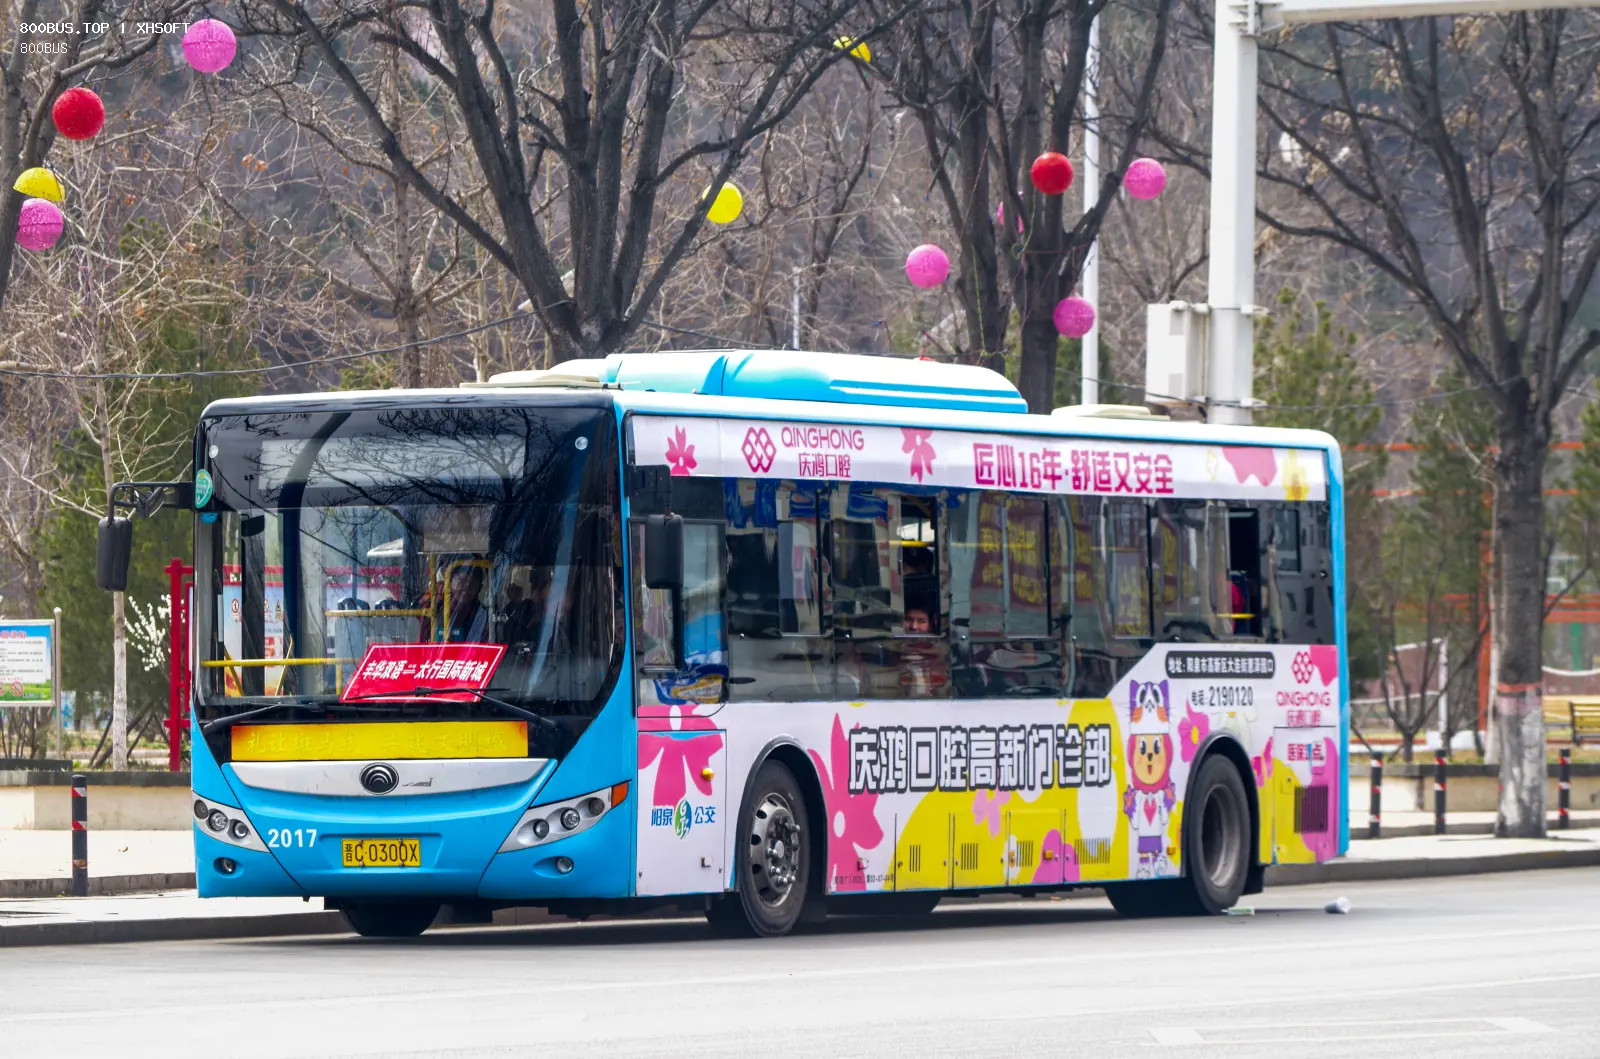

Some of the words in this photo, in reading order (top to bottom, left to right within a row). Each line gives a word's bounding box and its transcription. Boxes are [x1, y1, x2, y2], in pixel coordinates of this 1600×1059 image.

[781, 426, 865, 451] QINGHONG
[798, 452, 851, 478] 庆鸿口腔
[414, 659, 489, 682] 太行国际新城
[1276, 691, 1332, 706] QINGHONG
[848, 724, 1112, 794] 庆鸿口腔高新门诊部
[651, 808, 673, 827] 阳泉
[694, 806, 716, 824] 公交
[267, 828, 317, 849] 2017
